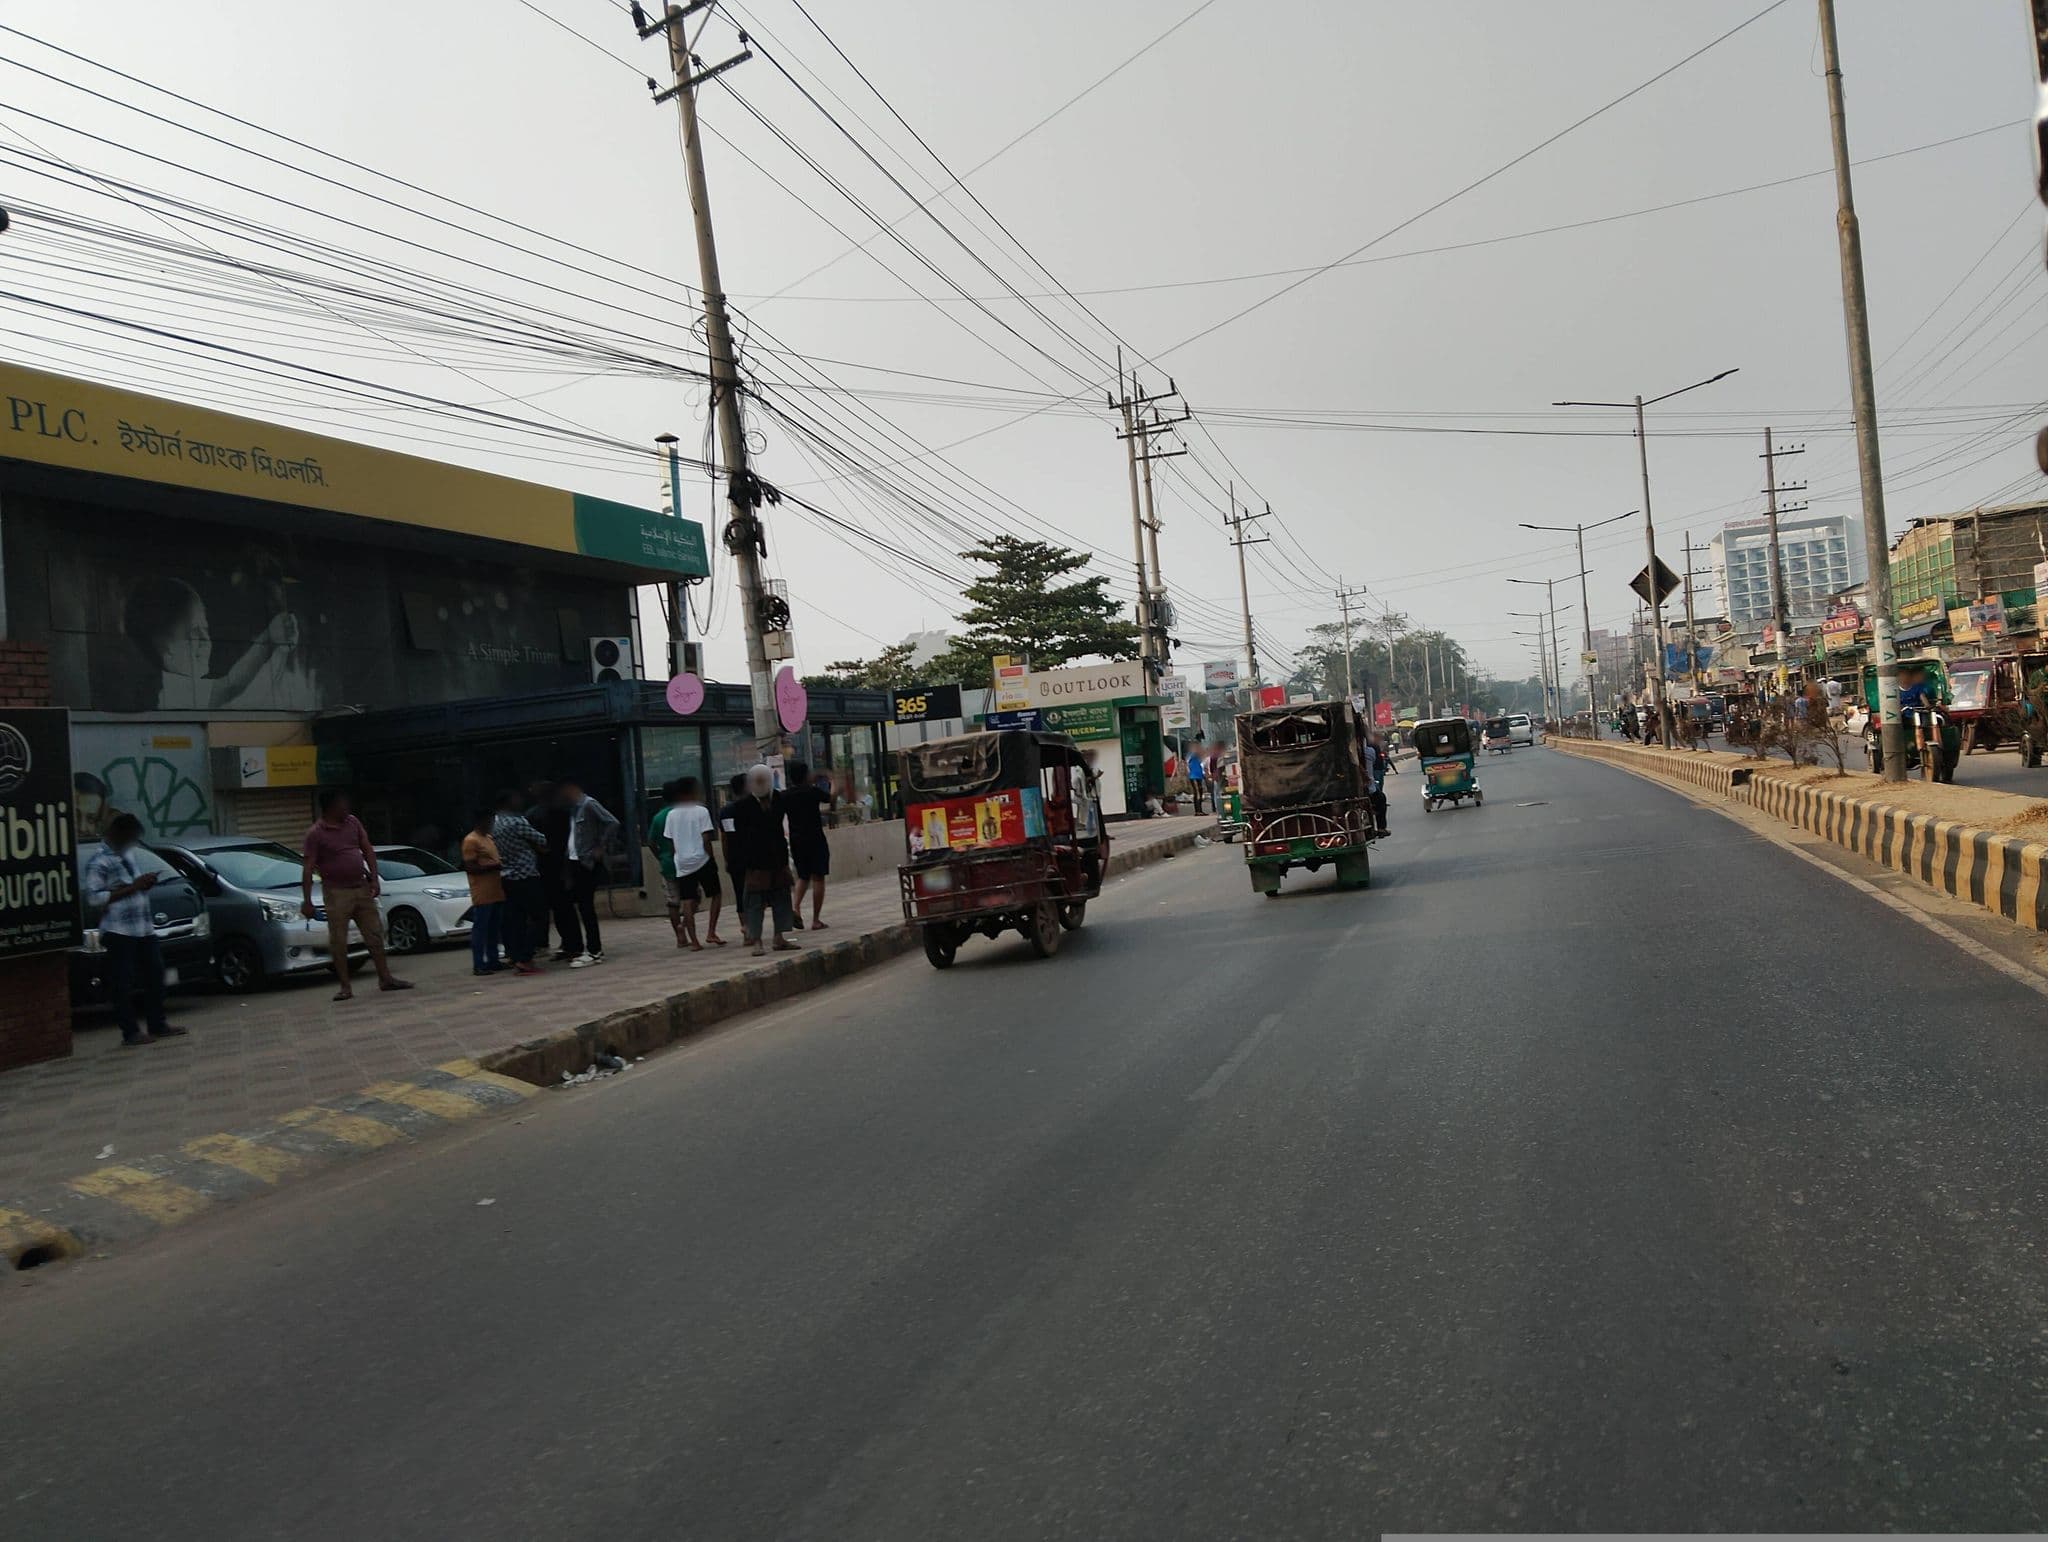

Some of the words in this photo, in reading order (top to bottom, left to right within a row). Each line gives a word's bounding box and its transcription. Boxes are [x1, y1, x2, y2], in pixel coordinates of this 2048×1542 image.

[6, 396, 98, 445] PLC.
[187, 440, 249, 473] ব্যাংক
[1052, 675, 1131, 696] OUTLOOK
[895, 695, 928, 714] 365
